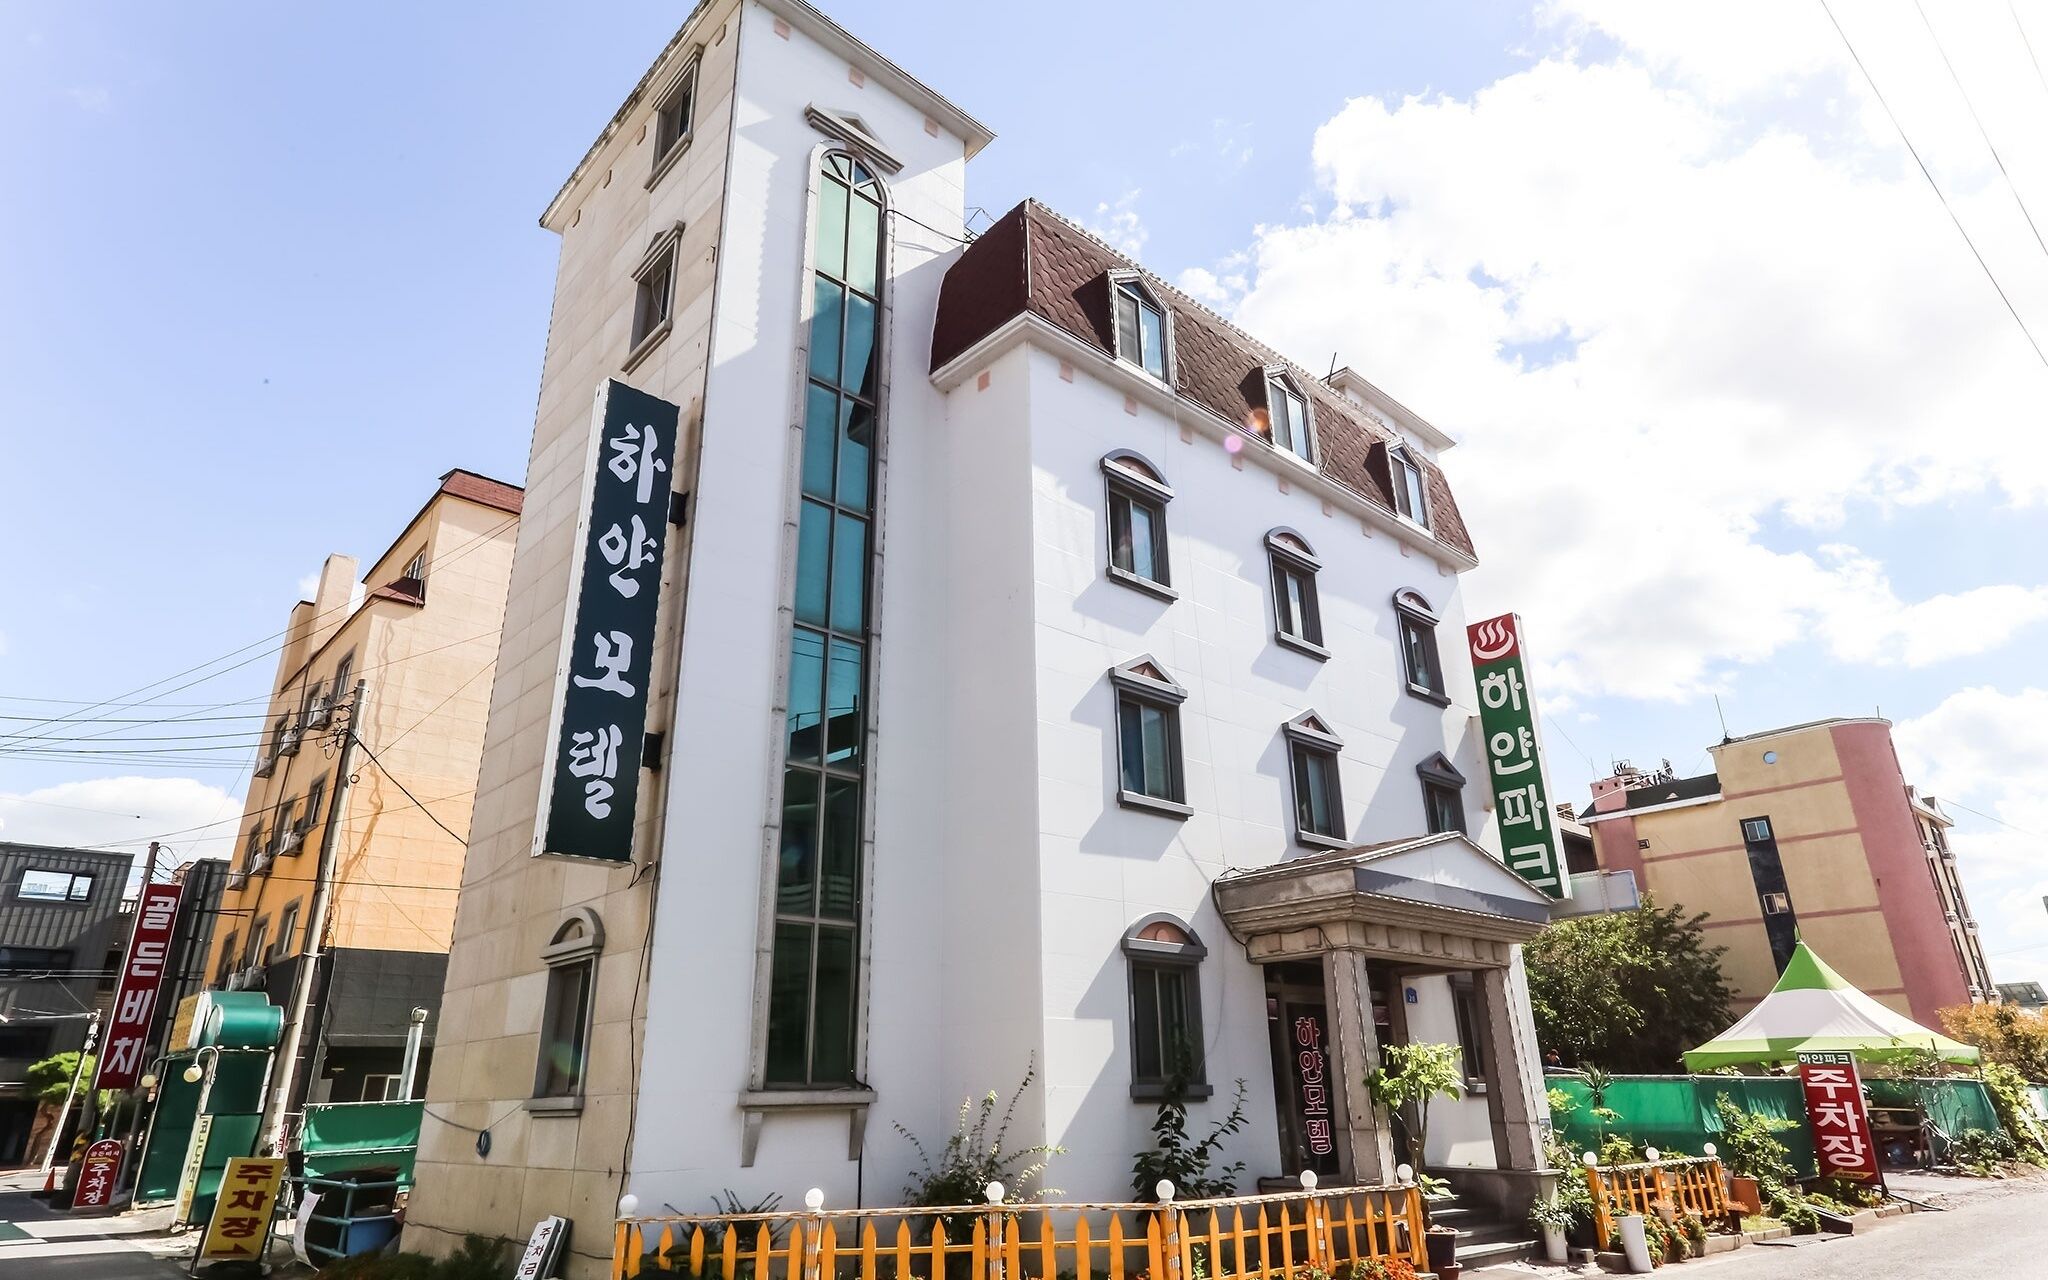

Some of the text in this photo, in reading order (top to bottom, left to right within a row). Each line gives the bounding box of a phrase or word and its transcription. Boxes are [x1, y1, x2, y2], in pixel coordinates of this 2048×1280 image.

[568, 423, 667, 820] 하얀모텔
[1480, 666, 1558, 888] 하얀파크
[103, 895, 177, 1075] 골든비치
[1295, 1016, 1333, 1155] 하얀모텔
[1799, 1053, 1851, 1065] 하얀파크
[1807, 1069, 1867, 1167] 주차장
[83, 1163, 111, 1204] 주차장
[220, 1165, 273, 1238] 주차장
